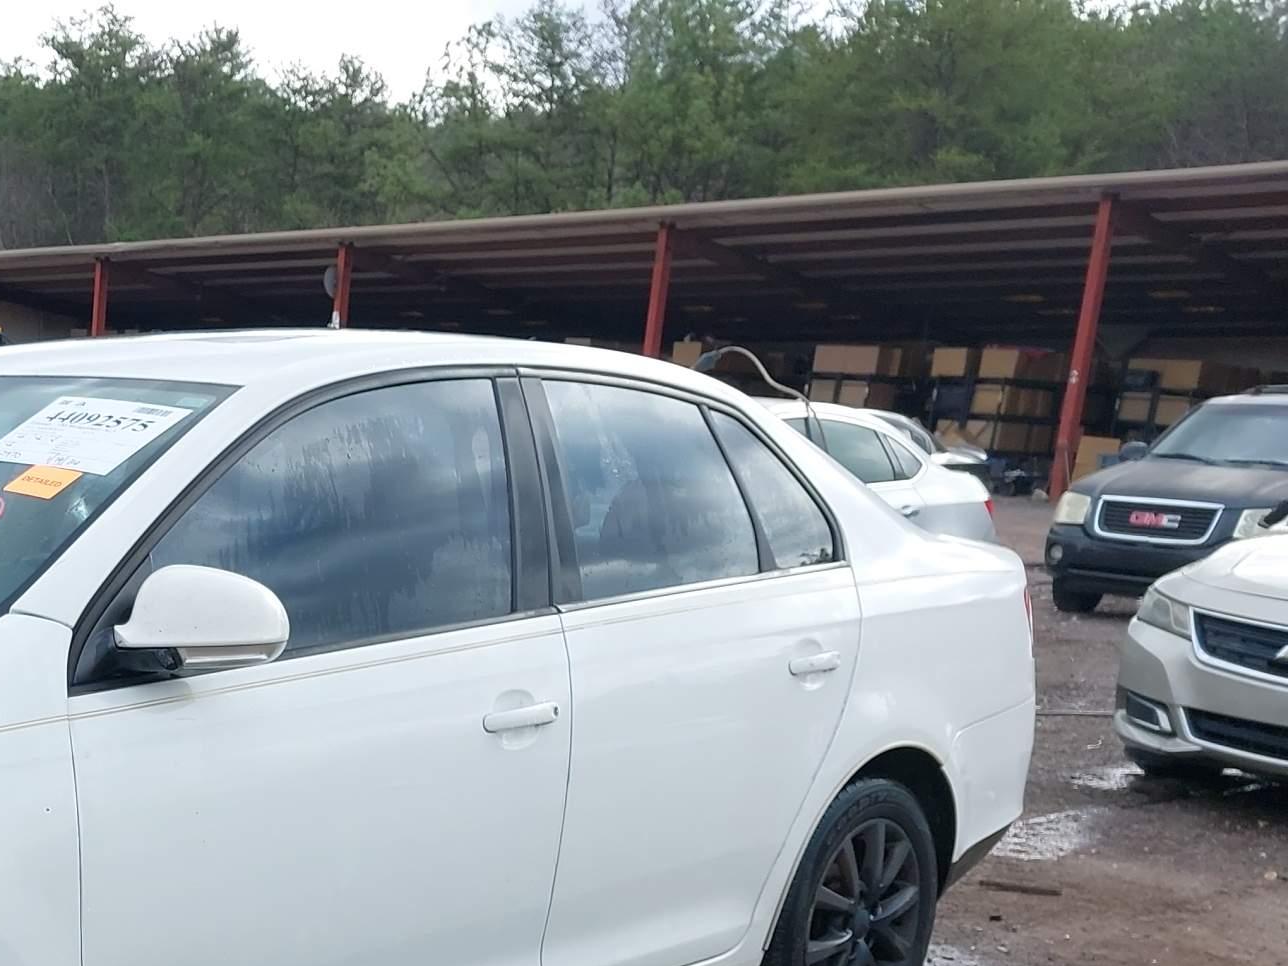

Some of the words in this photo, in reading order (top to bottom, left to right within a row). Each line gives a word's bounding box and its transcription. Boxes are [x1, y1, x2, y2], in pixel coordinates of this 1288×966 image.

[46, 410, 156, 432] 44092575
[21, 475, 63, 488] DETAILED
[1128, 510, 1183, 529] GMC
